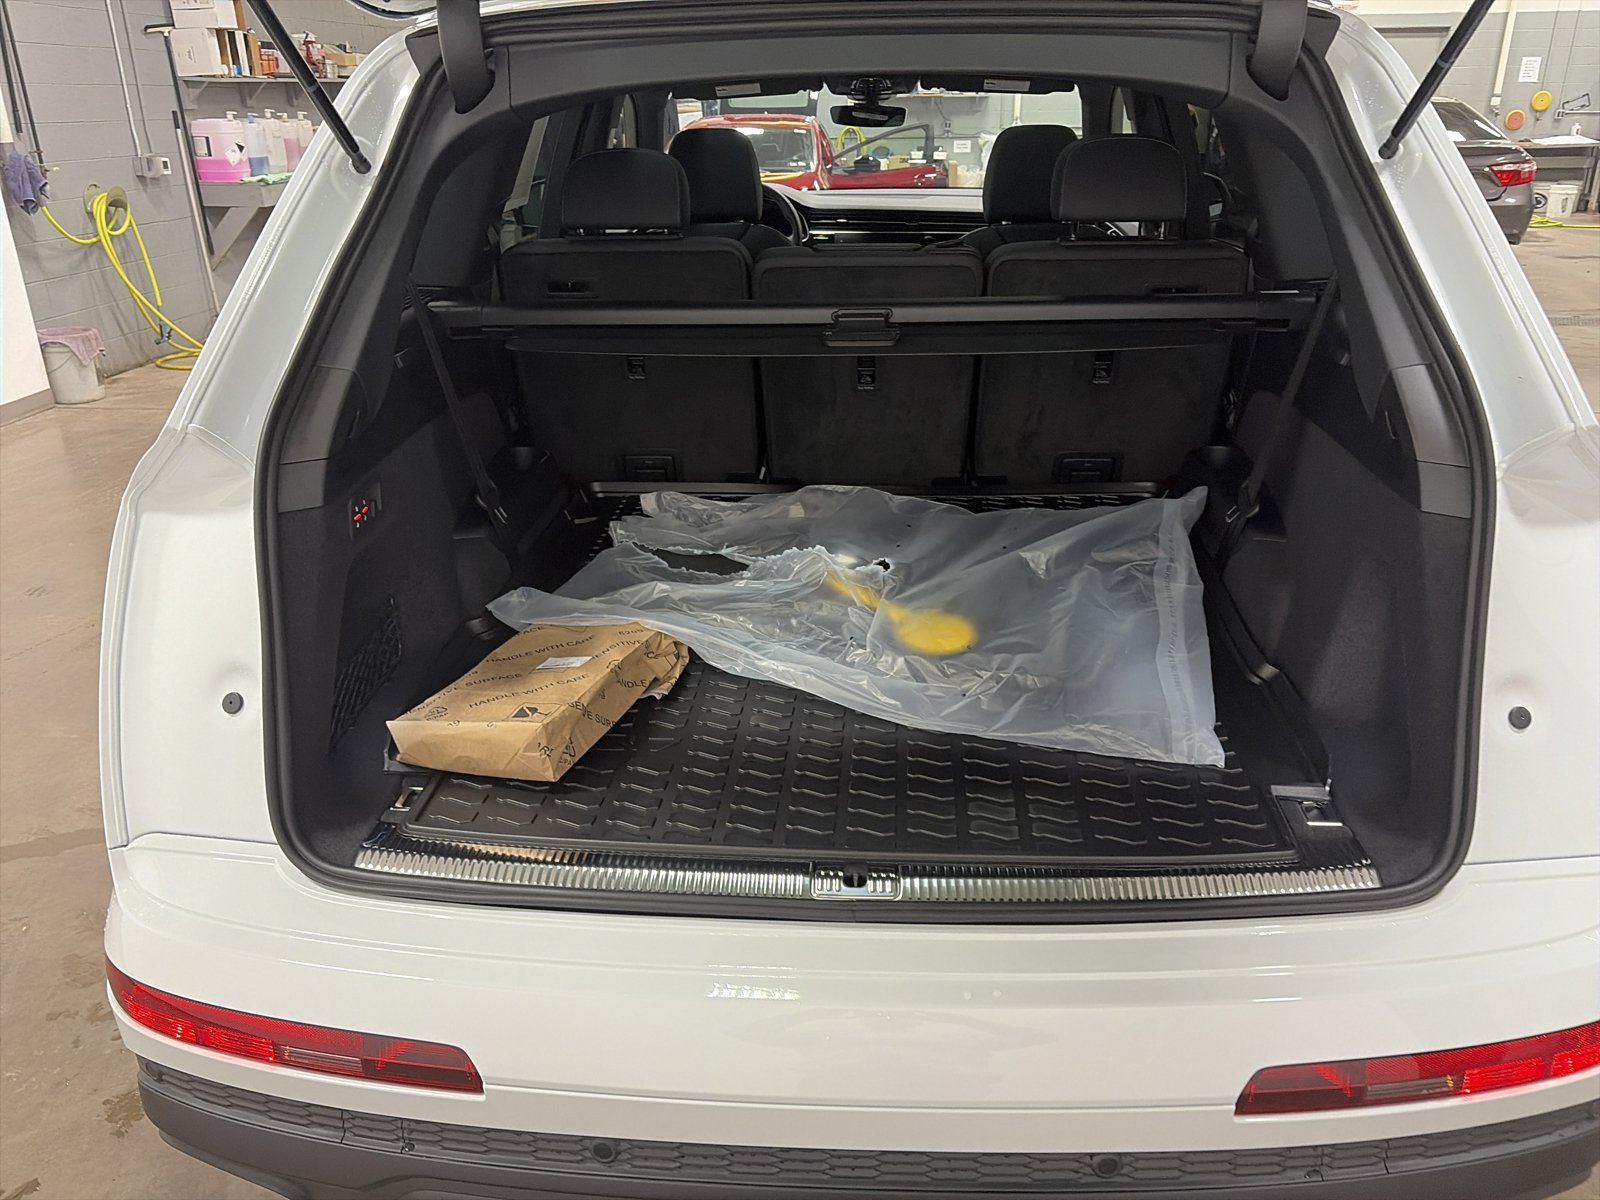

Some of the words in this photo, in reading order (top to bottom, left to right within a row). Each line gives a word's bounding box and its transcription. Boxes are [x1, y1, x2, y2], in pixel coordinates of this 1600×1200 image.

[486, 651, 532, 663] HANDLE
[535, 642, 564, 654] WITH
[566, 634, 596, 647] CARE
[465, 672, 523, 687] SURFACE
[468, 691, 520, 709] HANDLE
[522, 681, 554, 695] WITH
[556, 673, 590, 685] CARE
